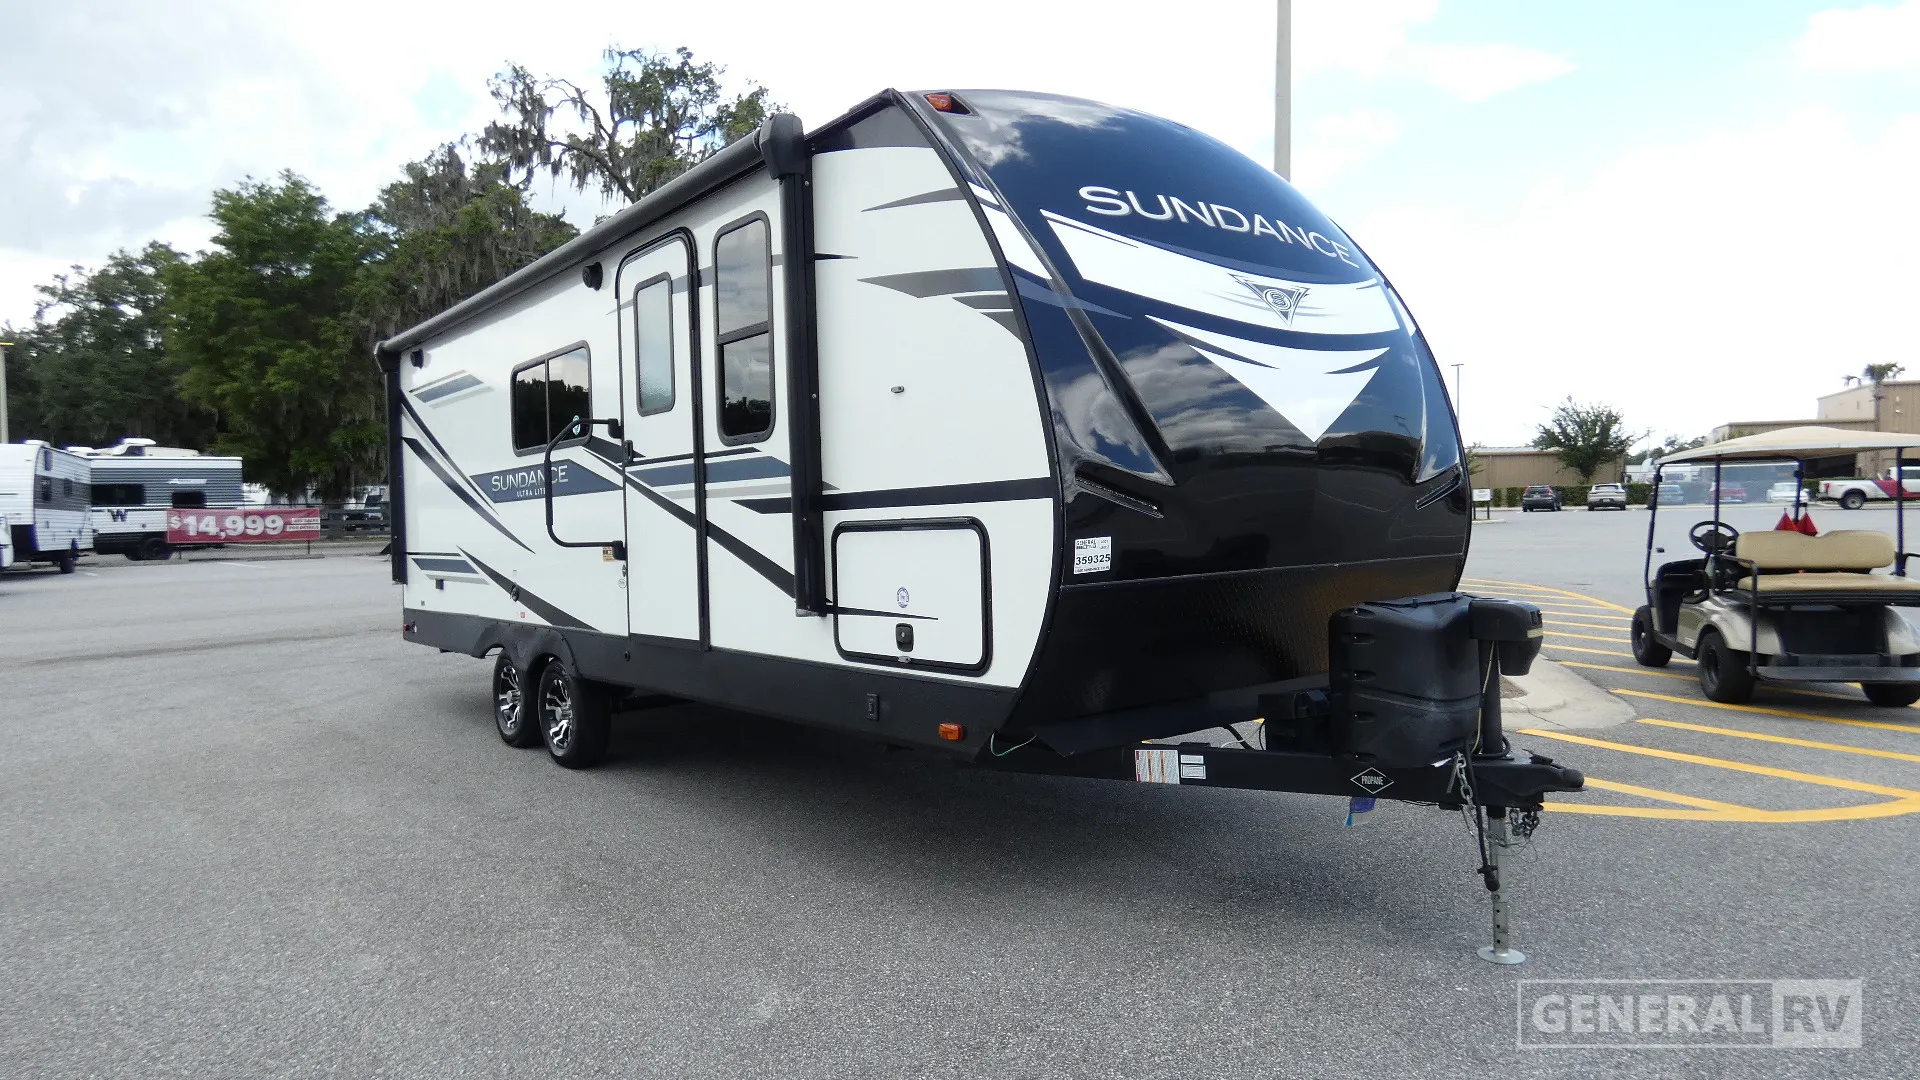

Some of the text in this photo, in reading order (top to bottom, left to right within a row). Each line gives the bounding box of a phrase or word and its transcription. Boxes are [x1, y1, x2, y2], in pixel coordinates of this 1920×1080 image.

[1078, 186, 1359, 269] SUNDANCE
[491, 465, 569, 491] SUNDANCE
[516, 489, 533, 498] ULTRA
[170, 514, 284, 540] $14,999
[1075, 553, 1111, 565] 359325
[1361, 775, 1384, 786] PROPANE
